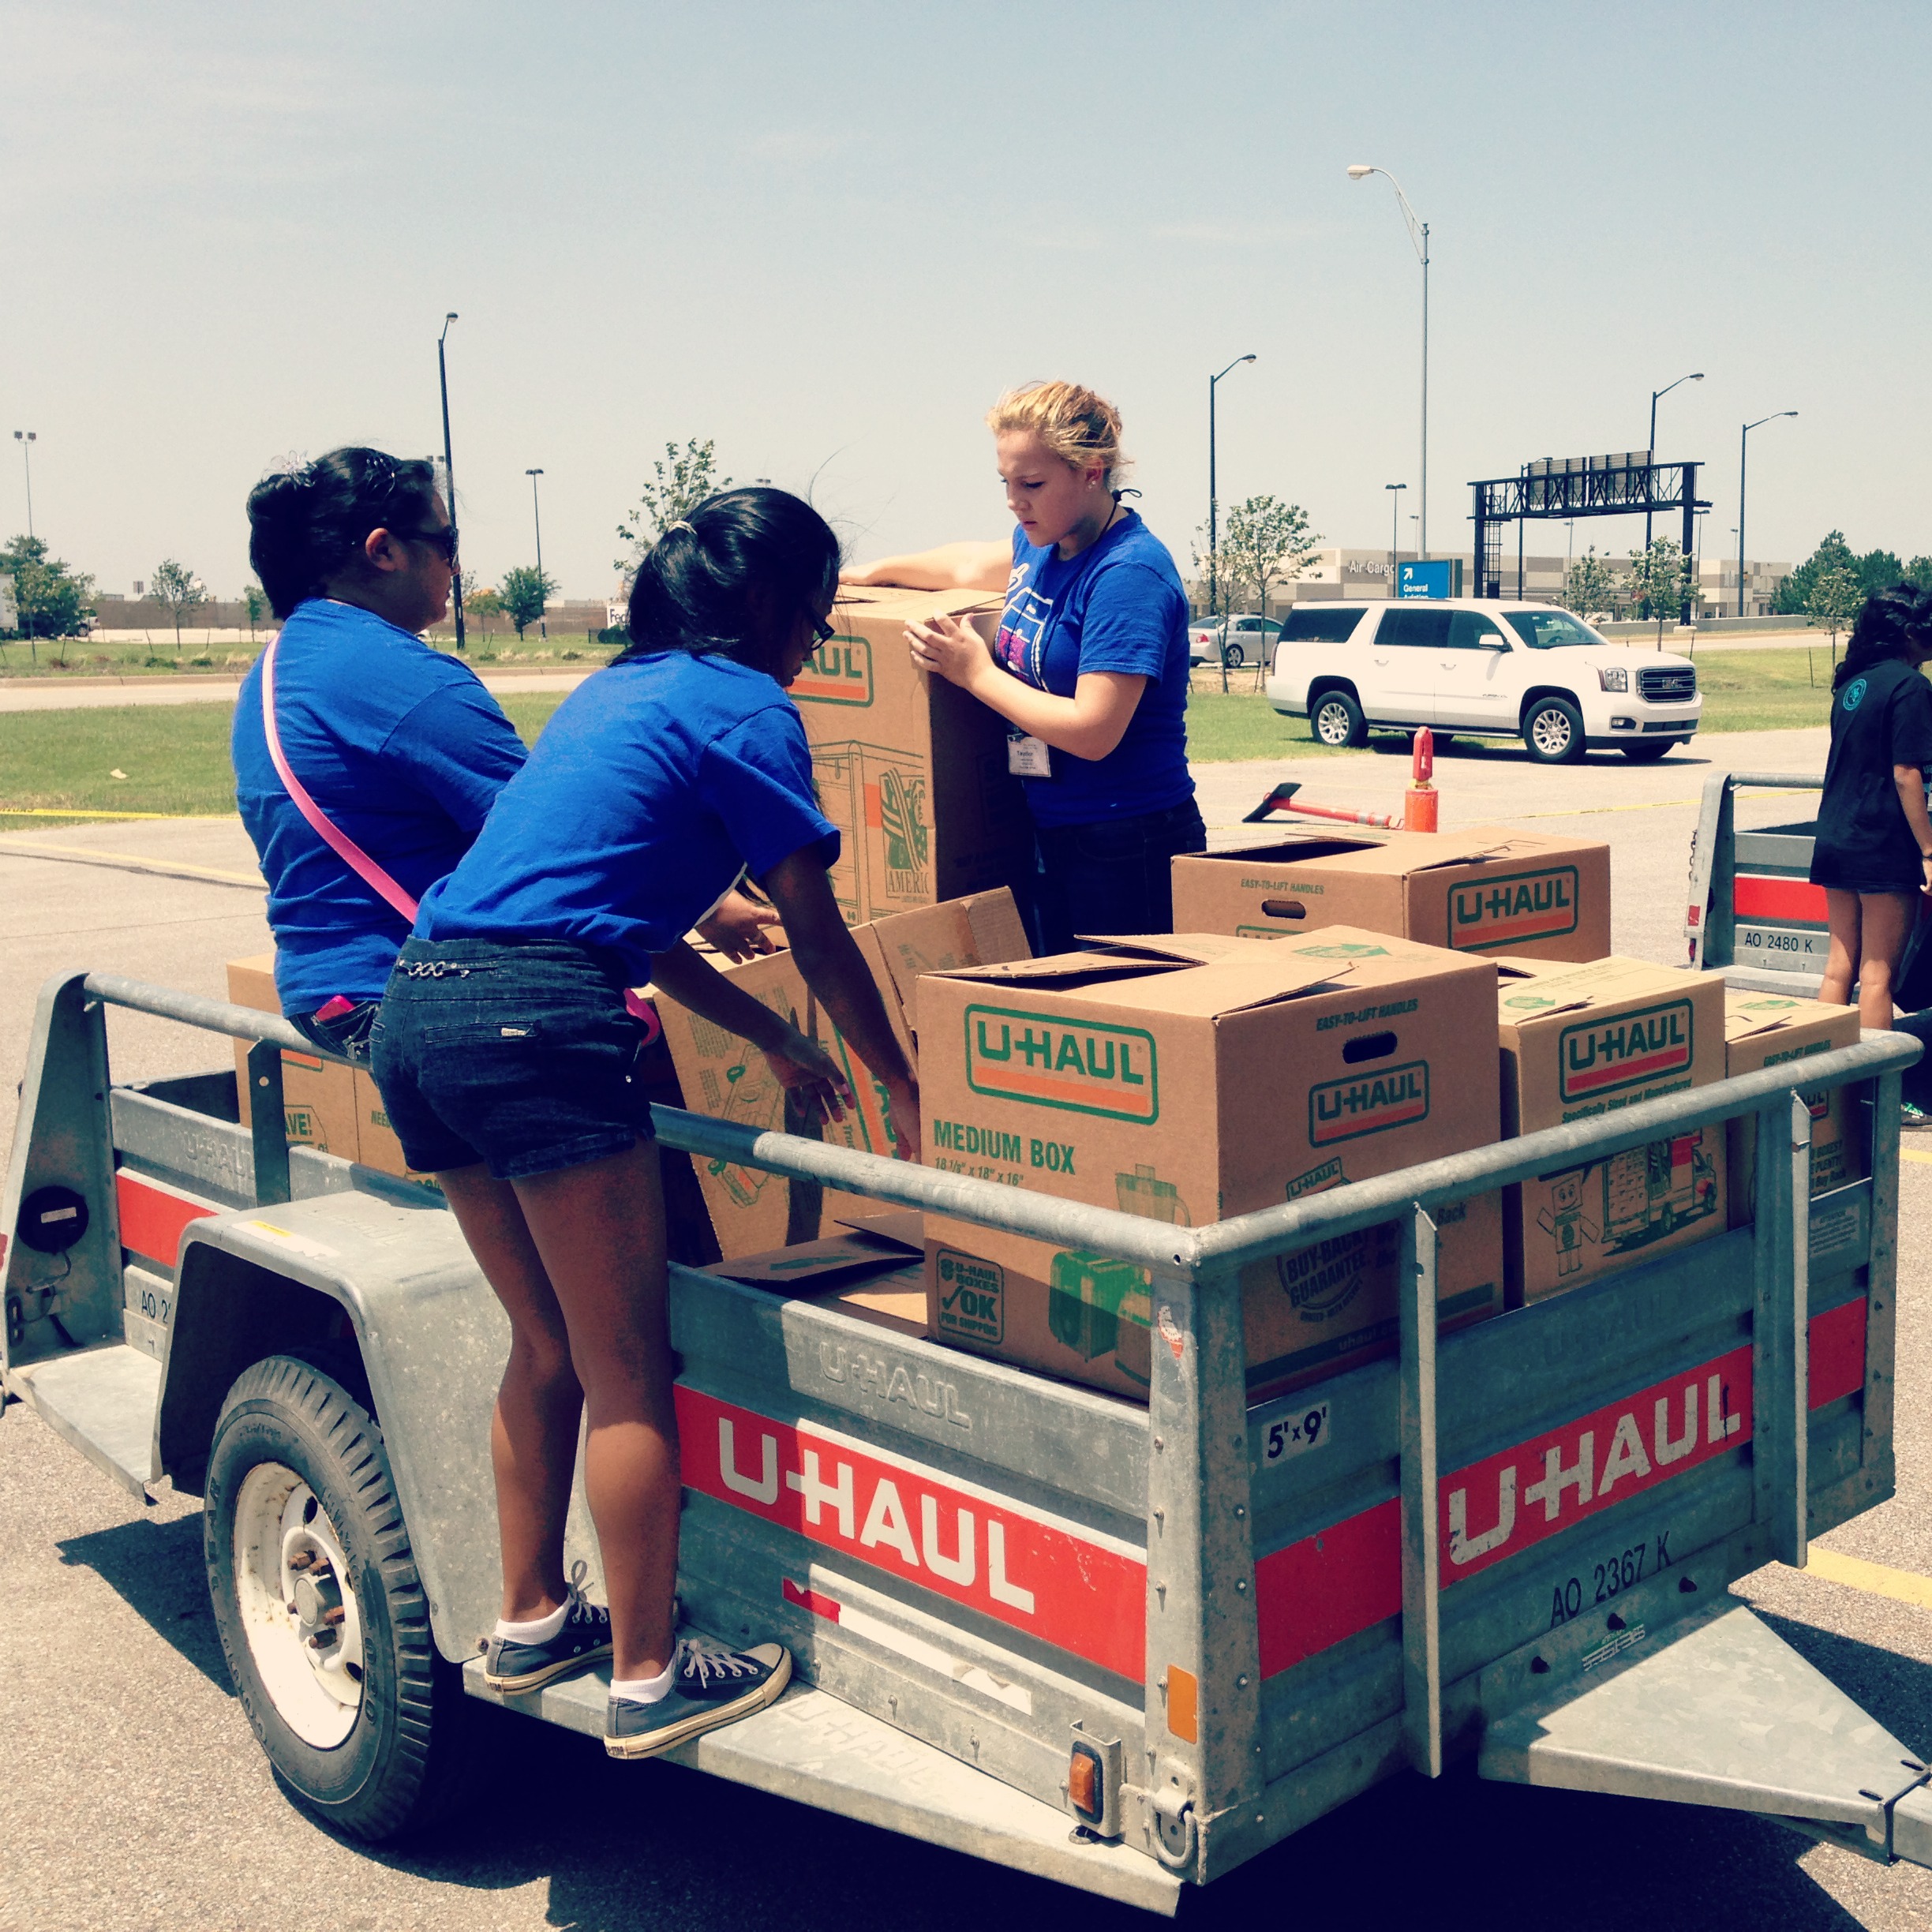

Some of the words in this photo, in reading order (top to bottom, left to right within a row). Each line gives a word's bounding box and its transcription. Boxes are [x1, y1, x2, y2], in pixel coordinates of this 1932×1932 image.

[1349, 560, 1363, 574] Air
[1366, 560, 1395, 577] Cargo
[1403, 583, 1428, 593] General
[1241, 878, 1289, 892] EASY-TO-LIFT
[1290, 882, 1325, 895] HANDLES
[1456, 878, 1571, 925] U-HAUL
[1767, 934, 1799, 952] 2480
[1804, 939, 1813, 953] K
[1316, 1005, 1378, 1032] EASY-TO-LIFT
[1378, 998, 1419, 1019] HANDLES
[976, 1020, 1144, 1086] U-HAUL
[1568, 1013, 1687, 1072] U-HAUL
[1317, 1072, 1423, 1121] U-HAUL
[933, 1118, 1022, 1164] MEDIUM
[1030, 1137, 1076, 1176] BOX
[1290, 1161, 1340, 1196] U-HAUL
[955, 1261, 999, 1283] U-HAUL
[956, 1273, 1000, 1294] BOXES
[960, 1290, 998, 1323] OK
[819, 1340, 973, 1432] U-HAUL
[1447, 1372, 1741, 1567] U-HAUL
[717, 1417, 1035, 1616] U-HAUL
[1593, 1543, 1646, 1603] 2367
[1657, 1530, 1672, 1571] K
